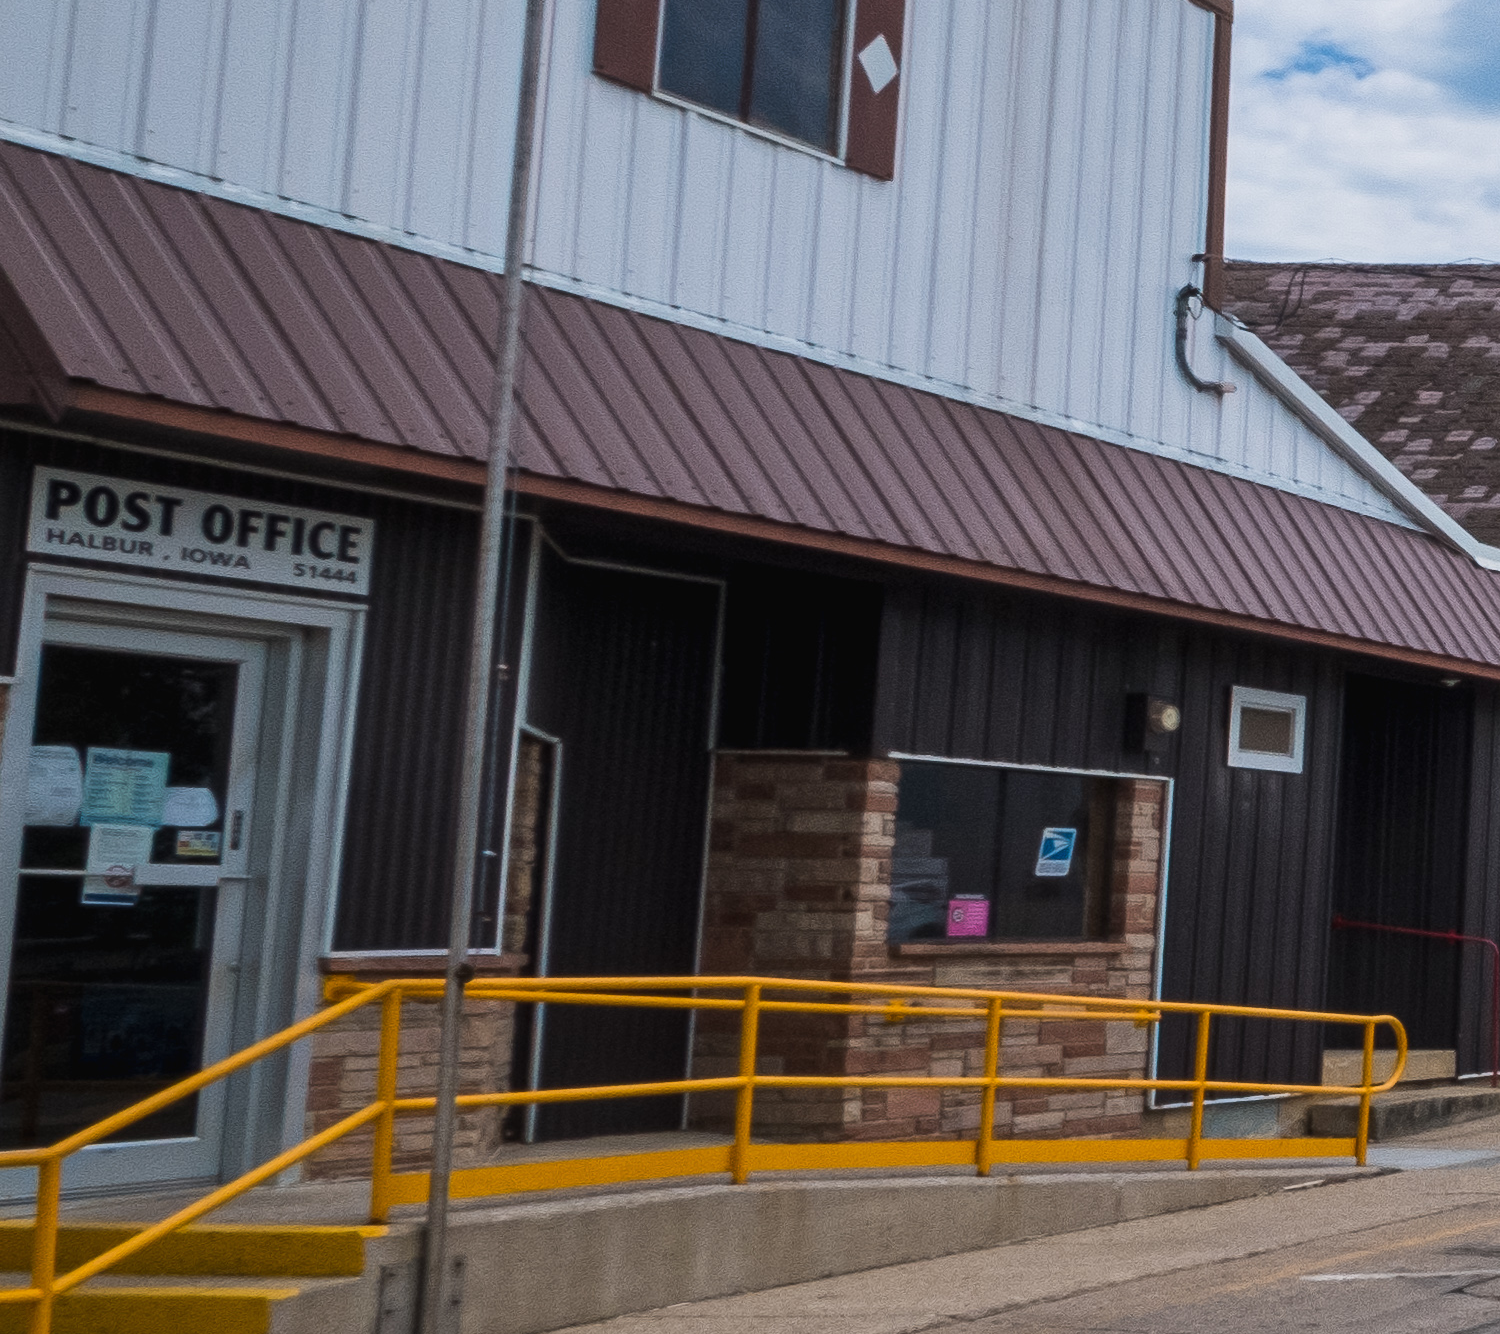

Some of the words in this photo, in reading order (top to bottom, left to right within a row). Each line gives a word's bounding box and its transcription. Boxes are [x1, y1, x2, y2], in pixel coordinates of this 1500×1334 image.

[44, 478, 183, 536] POST
[201, 504, 362, 564] OFFICE
[181, 547, 251, 569] IOWA
[294, 563, 358, 584] 51444
